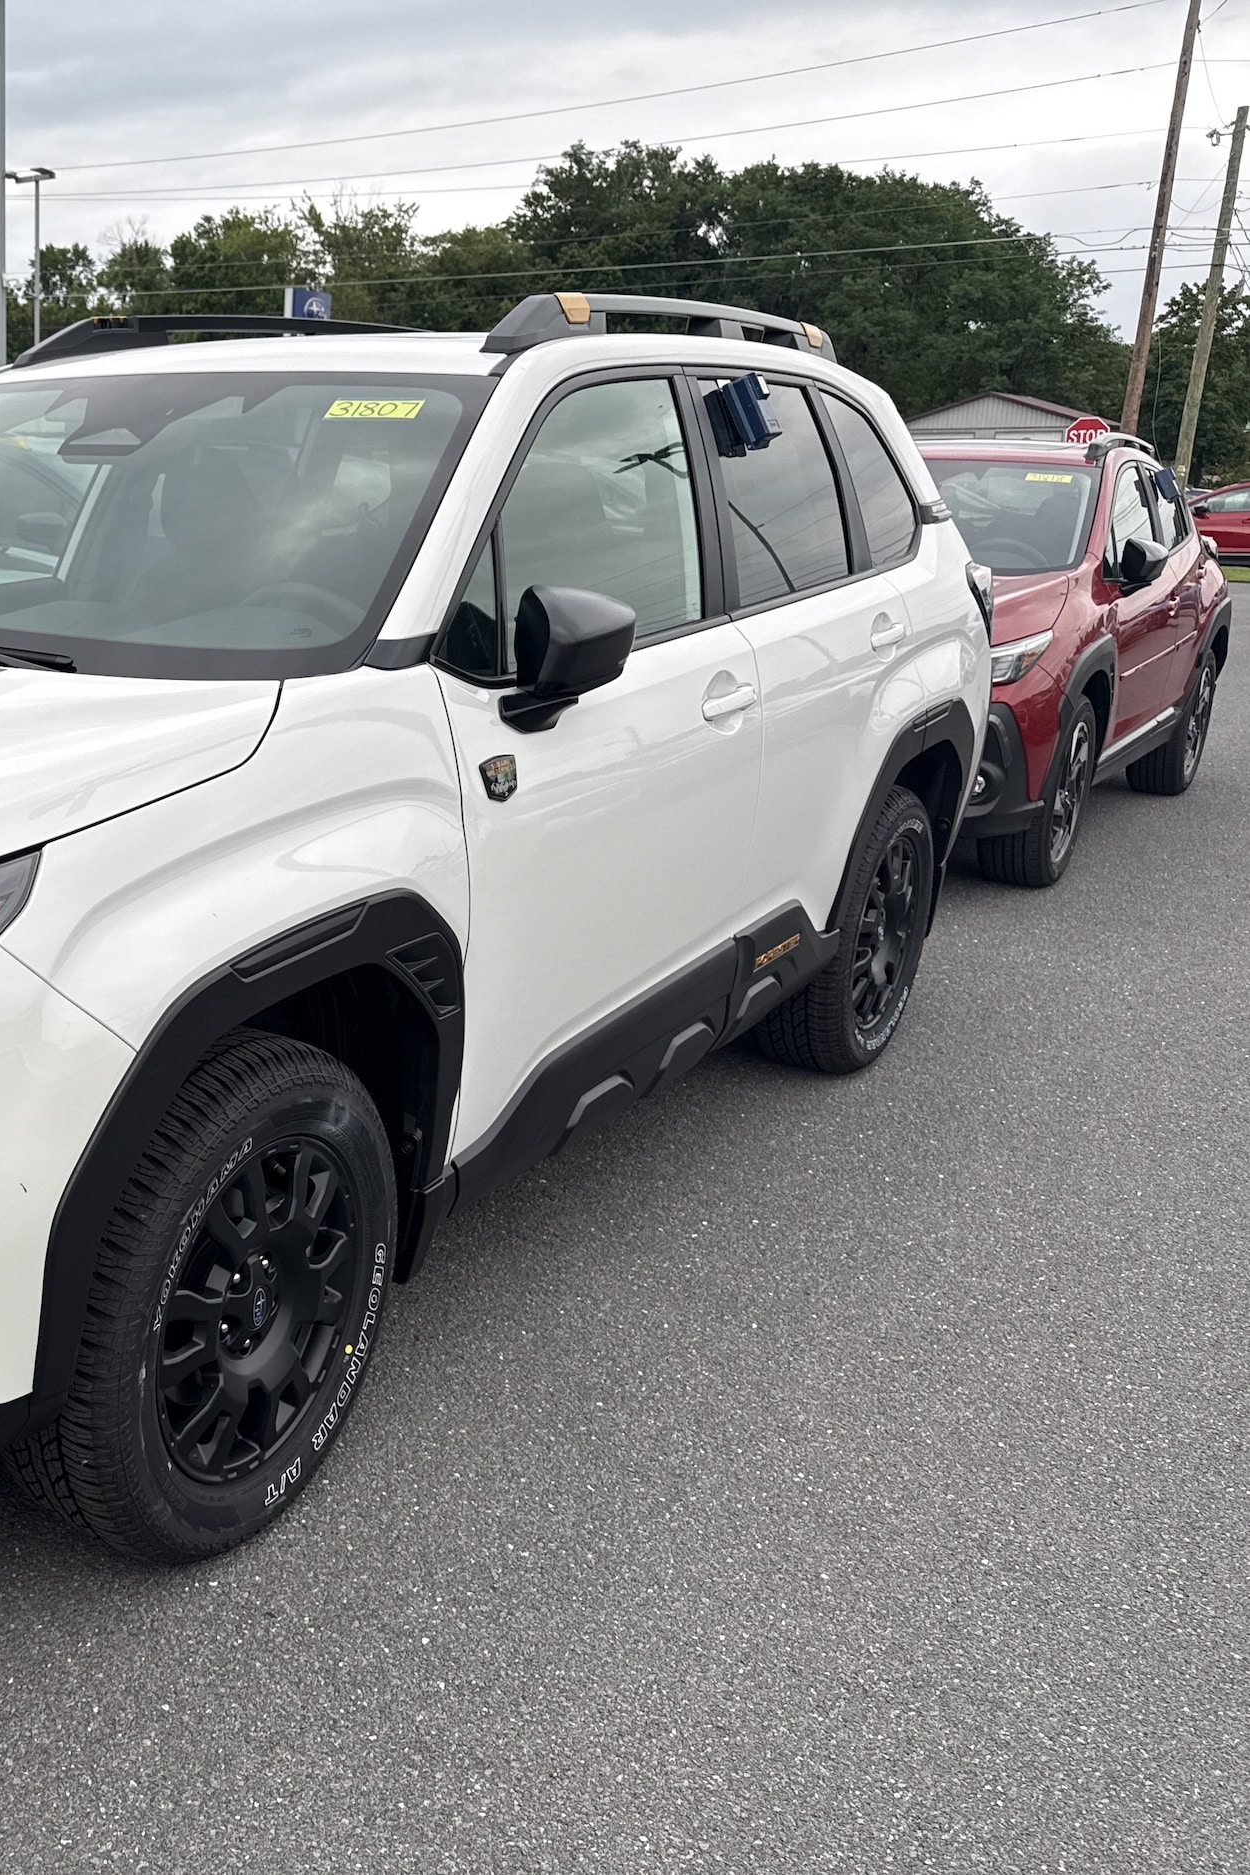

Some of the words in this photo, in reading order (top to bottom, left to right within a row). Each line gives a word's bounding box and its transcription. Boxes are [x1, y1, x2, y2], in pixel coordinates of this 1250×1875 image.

[329, 401, 420, 417] 31807
[153, 1137, 253, 1332] YOKOHAMA
[311, 1243, 387, 1451] GEOLANDAR
[264, 1456, 302, 1506] A/T
